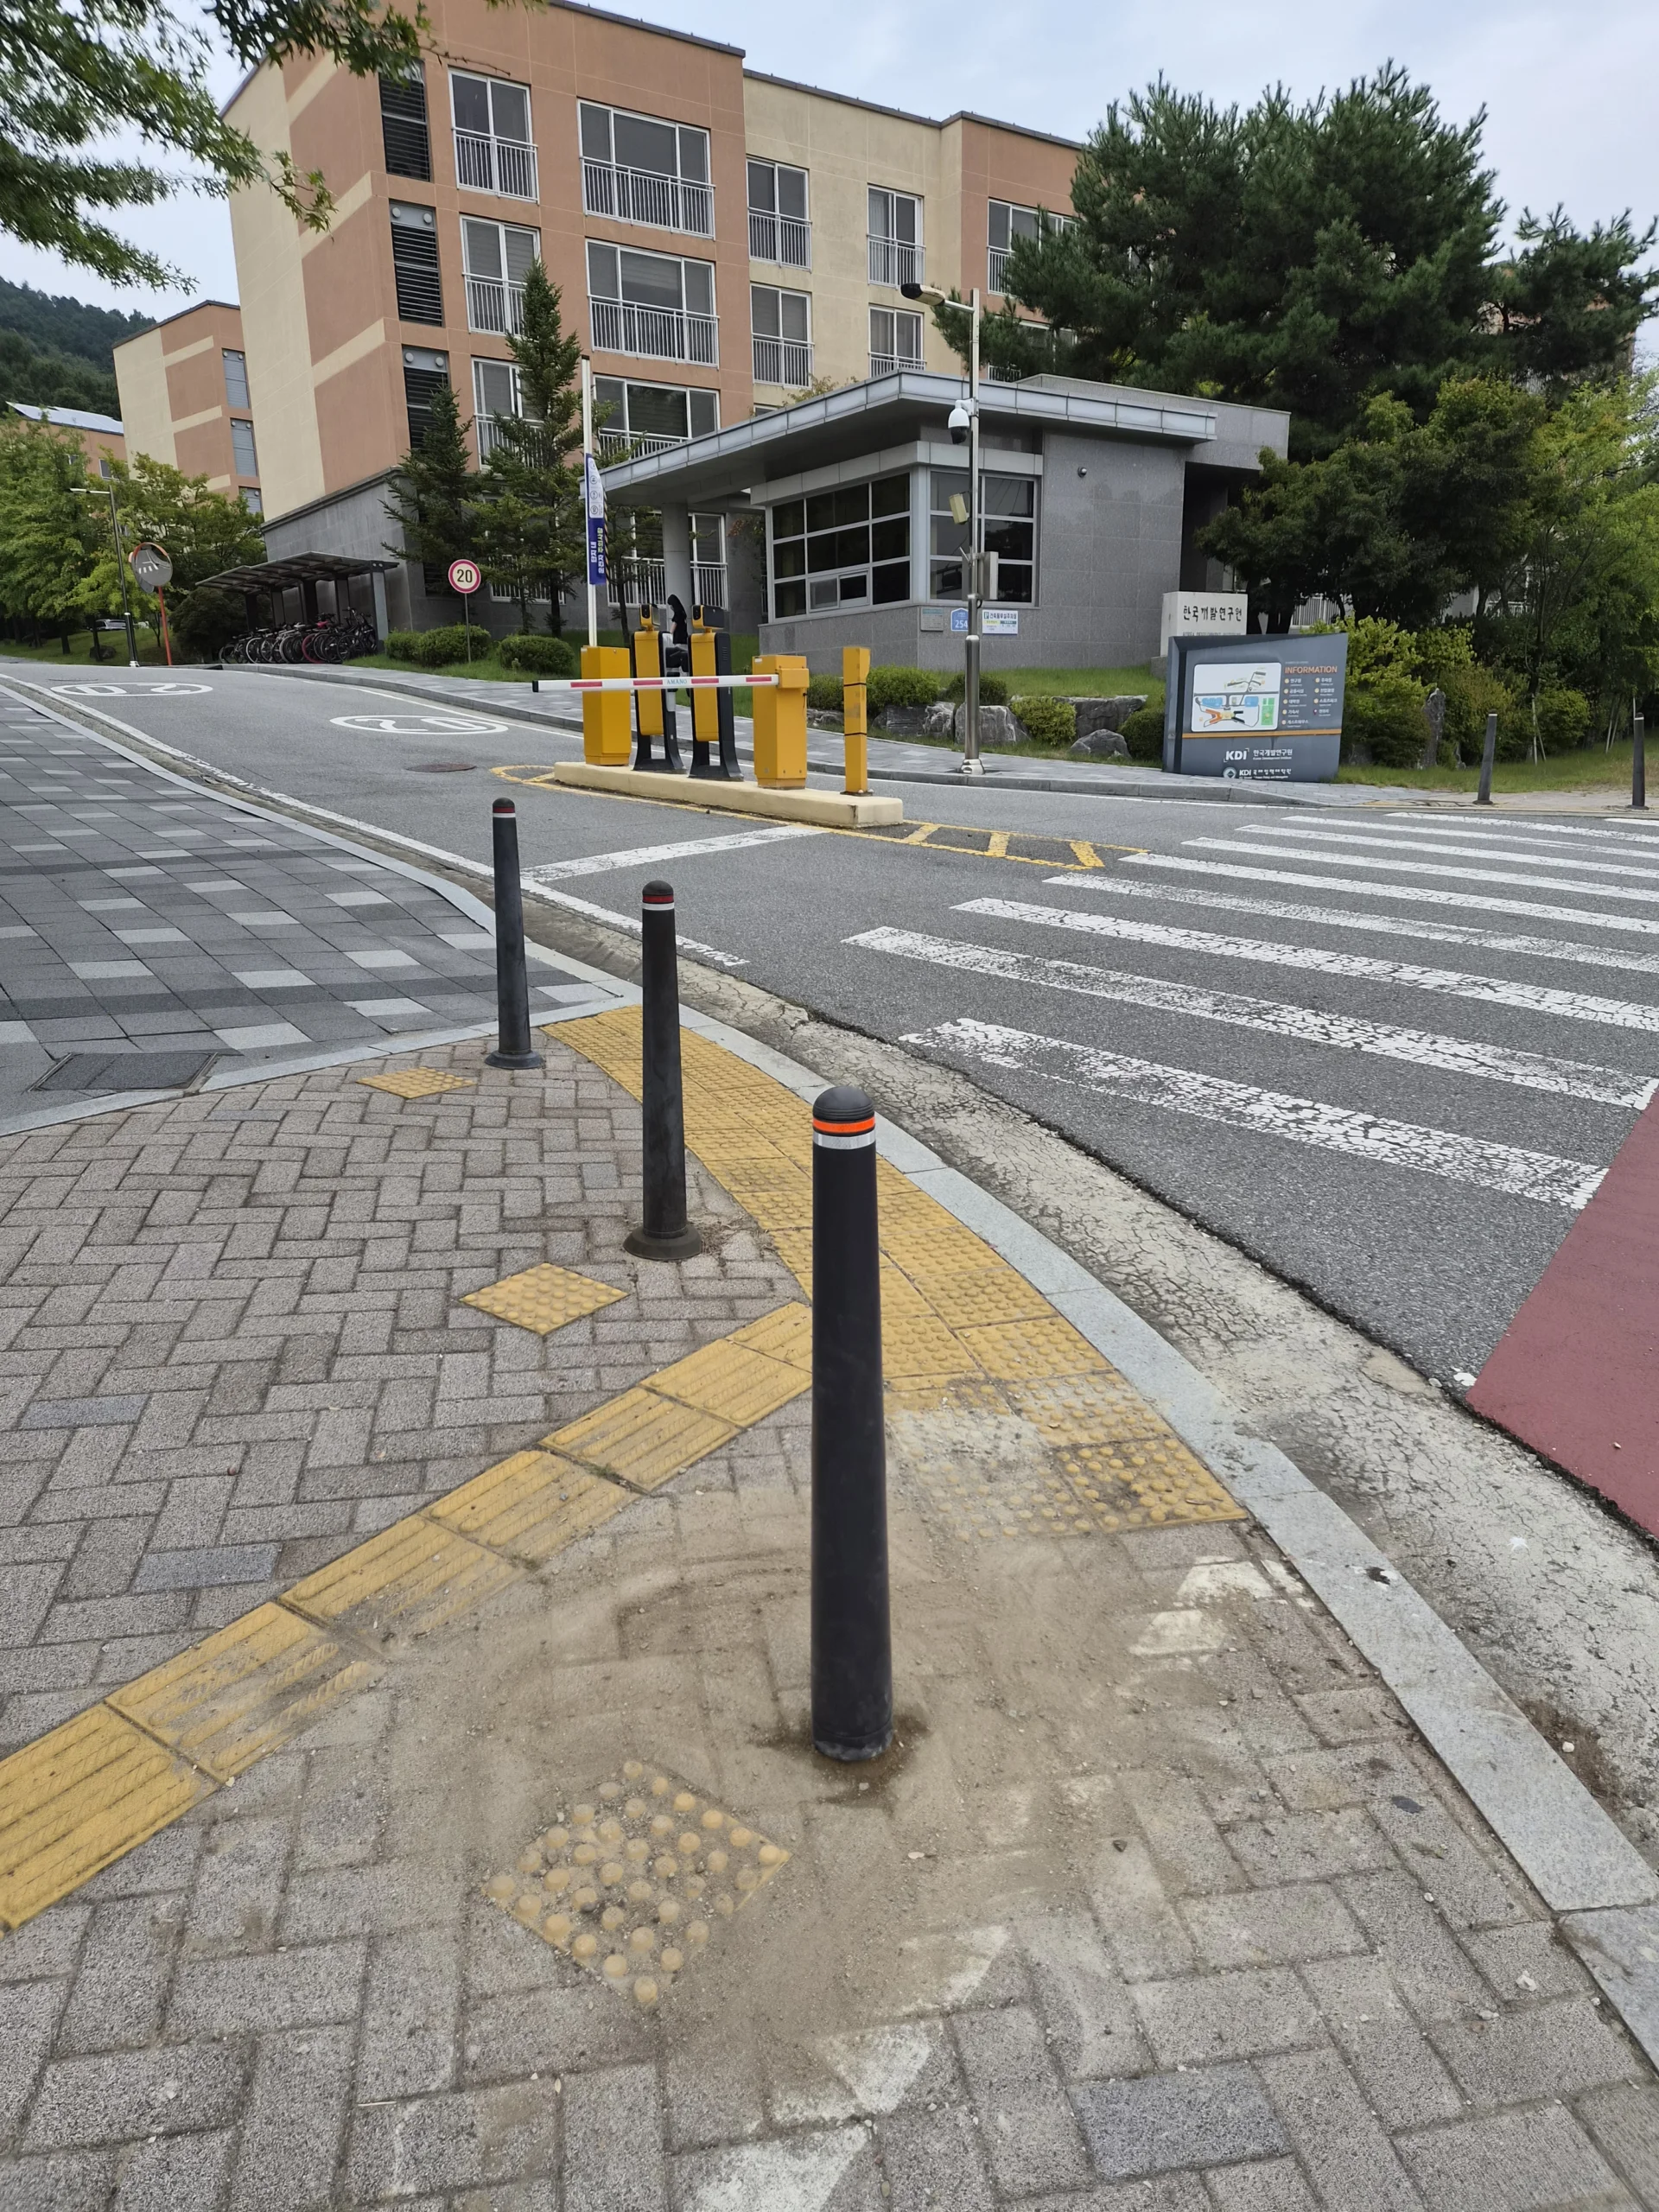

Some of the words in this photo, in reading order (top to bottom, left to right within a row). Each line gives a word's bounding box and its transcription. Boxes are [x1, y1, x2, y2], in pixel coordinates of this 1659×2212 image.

[457, 569, 473, 583] 20
[1183, 605, 1243, 622] 한국개발연구원
[955, 620, 968, 628] 254
[1285, 665, 1338, 674] INFORMATION
[358, 717, 479, 733] 20
[1225, 750, 1247, 760] KDI
